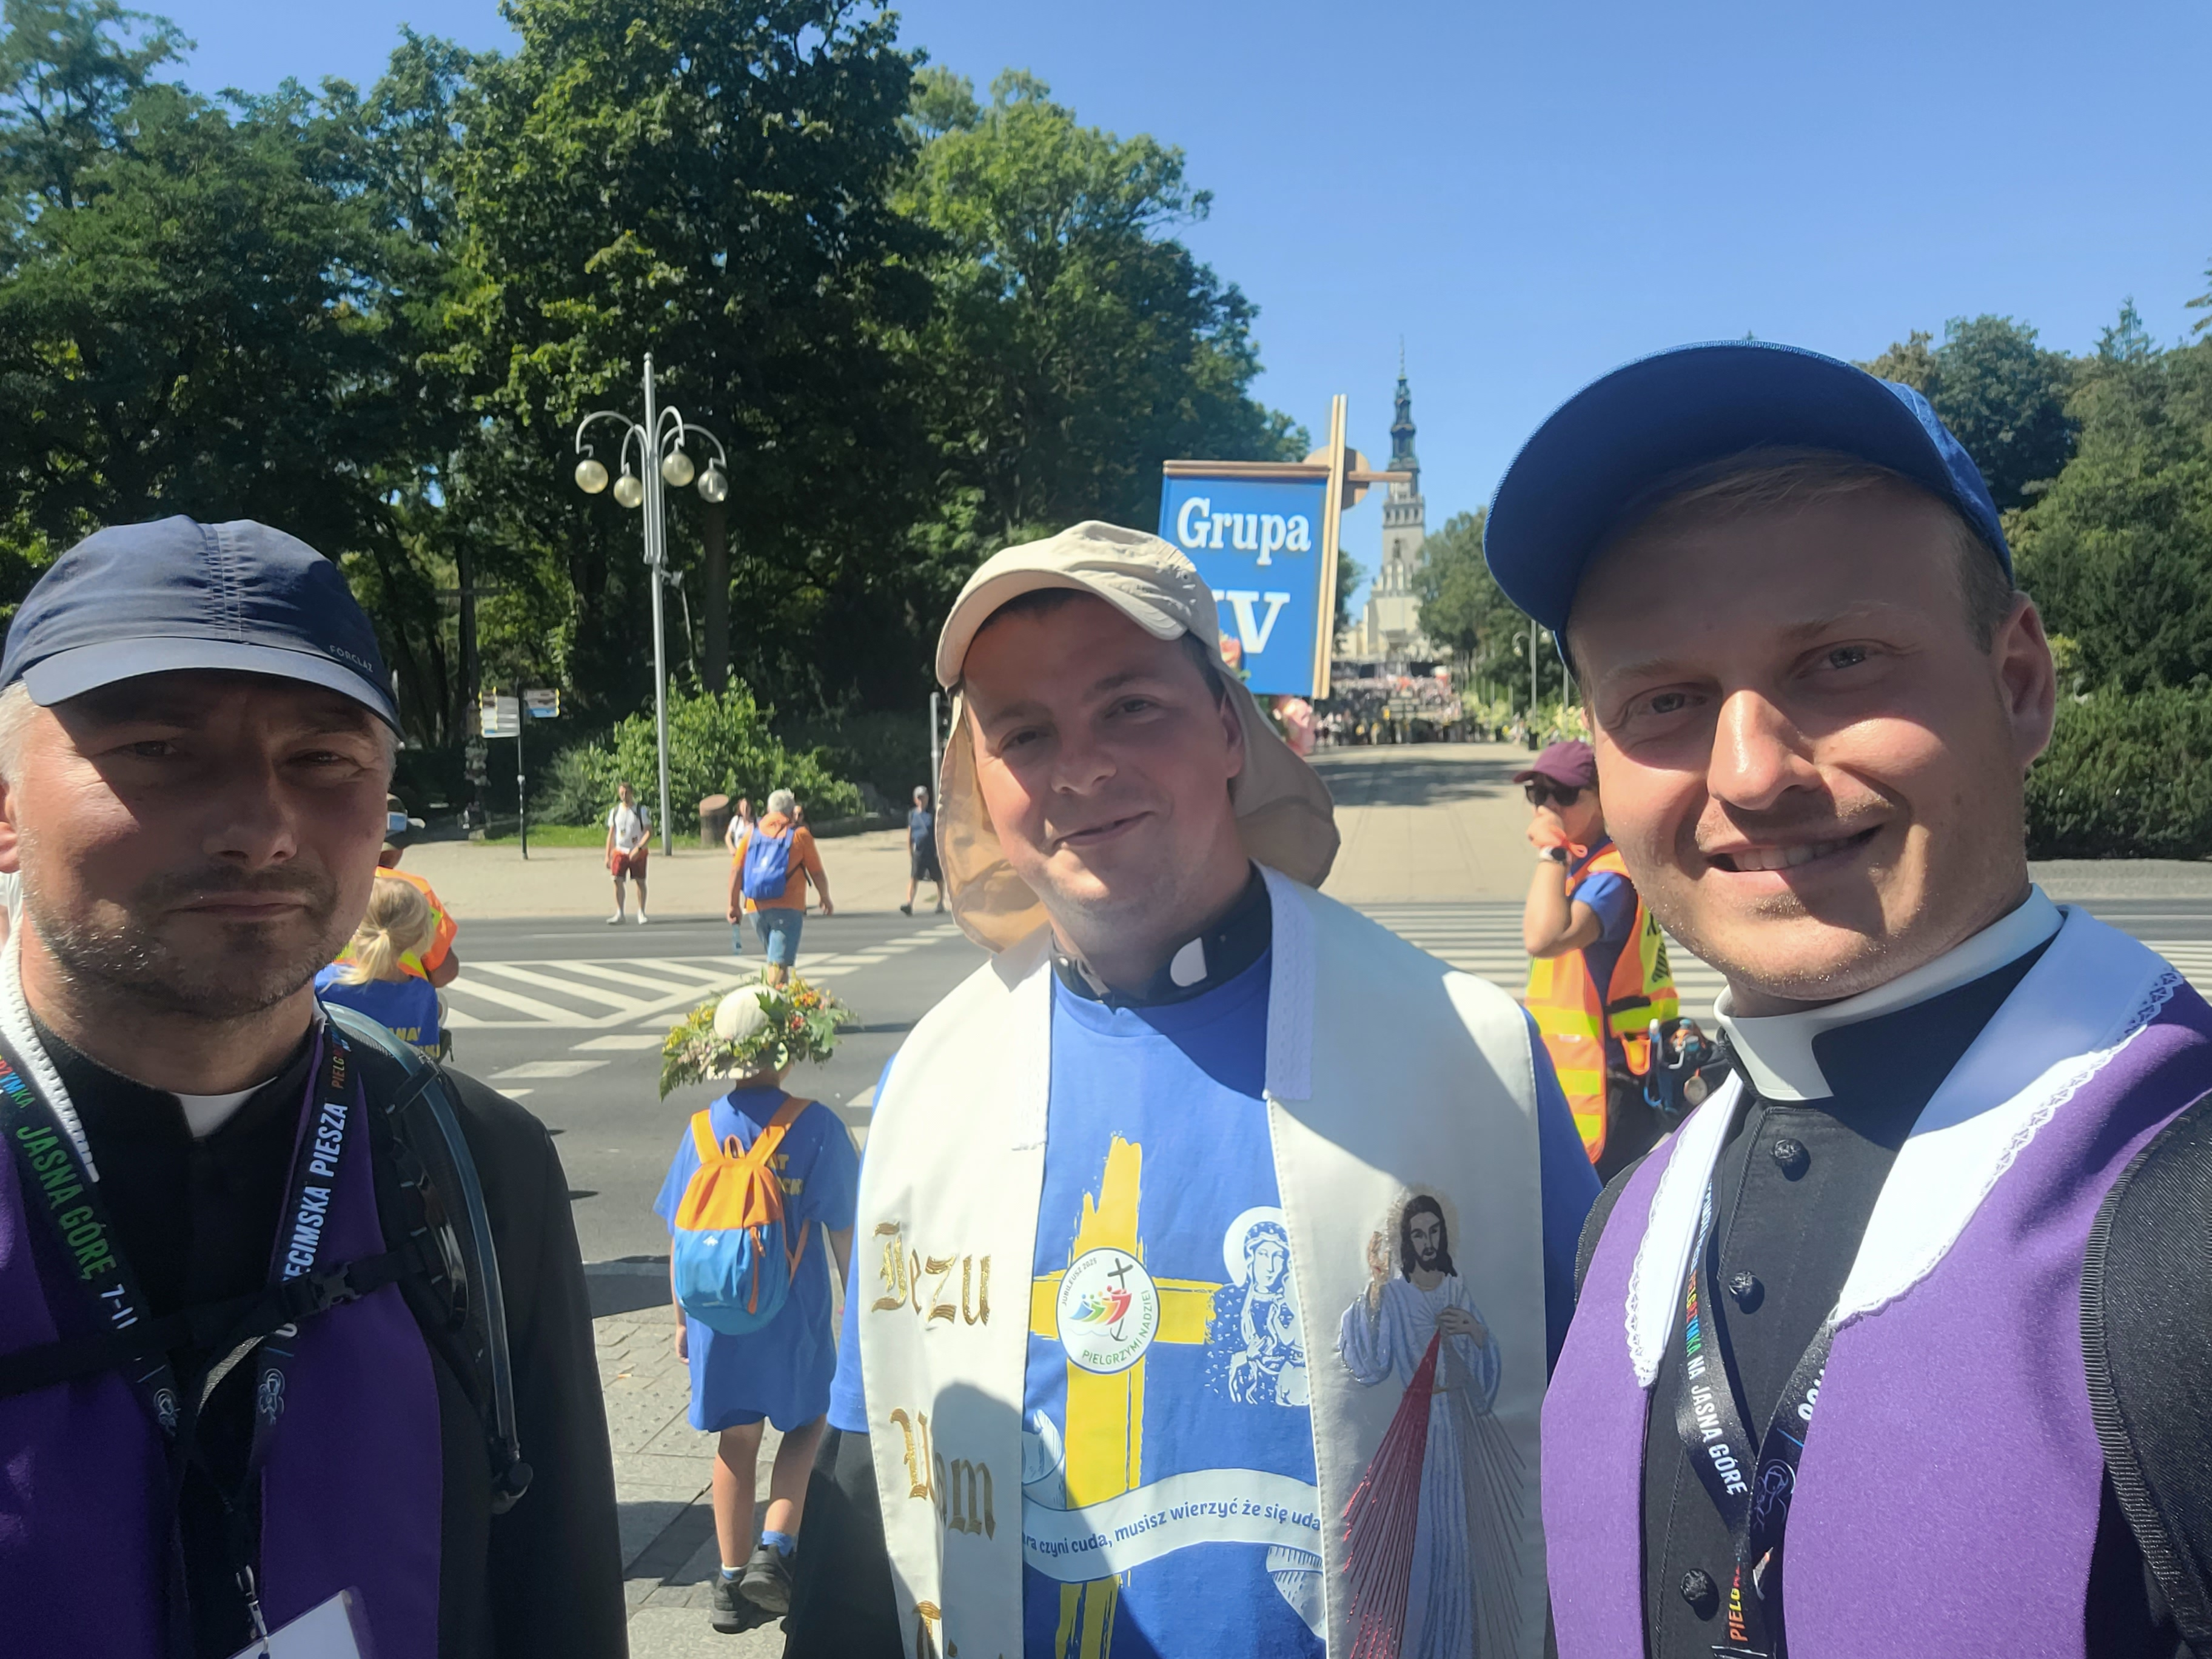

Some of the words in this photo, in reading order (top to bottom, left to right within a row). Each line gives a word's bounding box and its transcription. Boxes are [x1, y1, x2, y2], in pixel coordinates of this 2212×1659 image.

[1176, 497, 1312, 565] Grupa
[329, 645, 374, 673] FORCLAZ
[309, 1102, 349, 1178] PIESZA
[58, 1205, 116, 1280] GÓRĘ
[871, 1221, 991, 1326] Jezu
[1062, 1265, 1083, 1306] JUBILEUSZ
[1082, 1258, 1098, 1270] 2025
[1082, 1338, 1143, 1366] PIELGRZYMI
[1138, 1289, 1152, 1338] NADZIEI
[1687, 1355, 1706, 1380] NA
[1708, 1443, 1748, 1495] GÓRĘ
[1039, 1537, 1069, 1557] czyni
[1073, 1533, 1113, 1553] cuda,
[1114, 1511, 1167, 1542] musisz
[1170, 1497, 1238, 1521] wierzyć
[1241, 1499, 1262, 1516] że
[1264, 1503, 1288, 1524] się
[1291, 1511, 1320, 1531] uda
